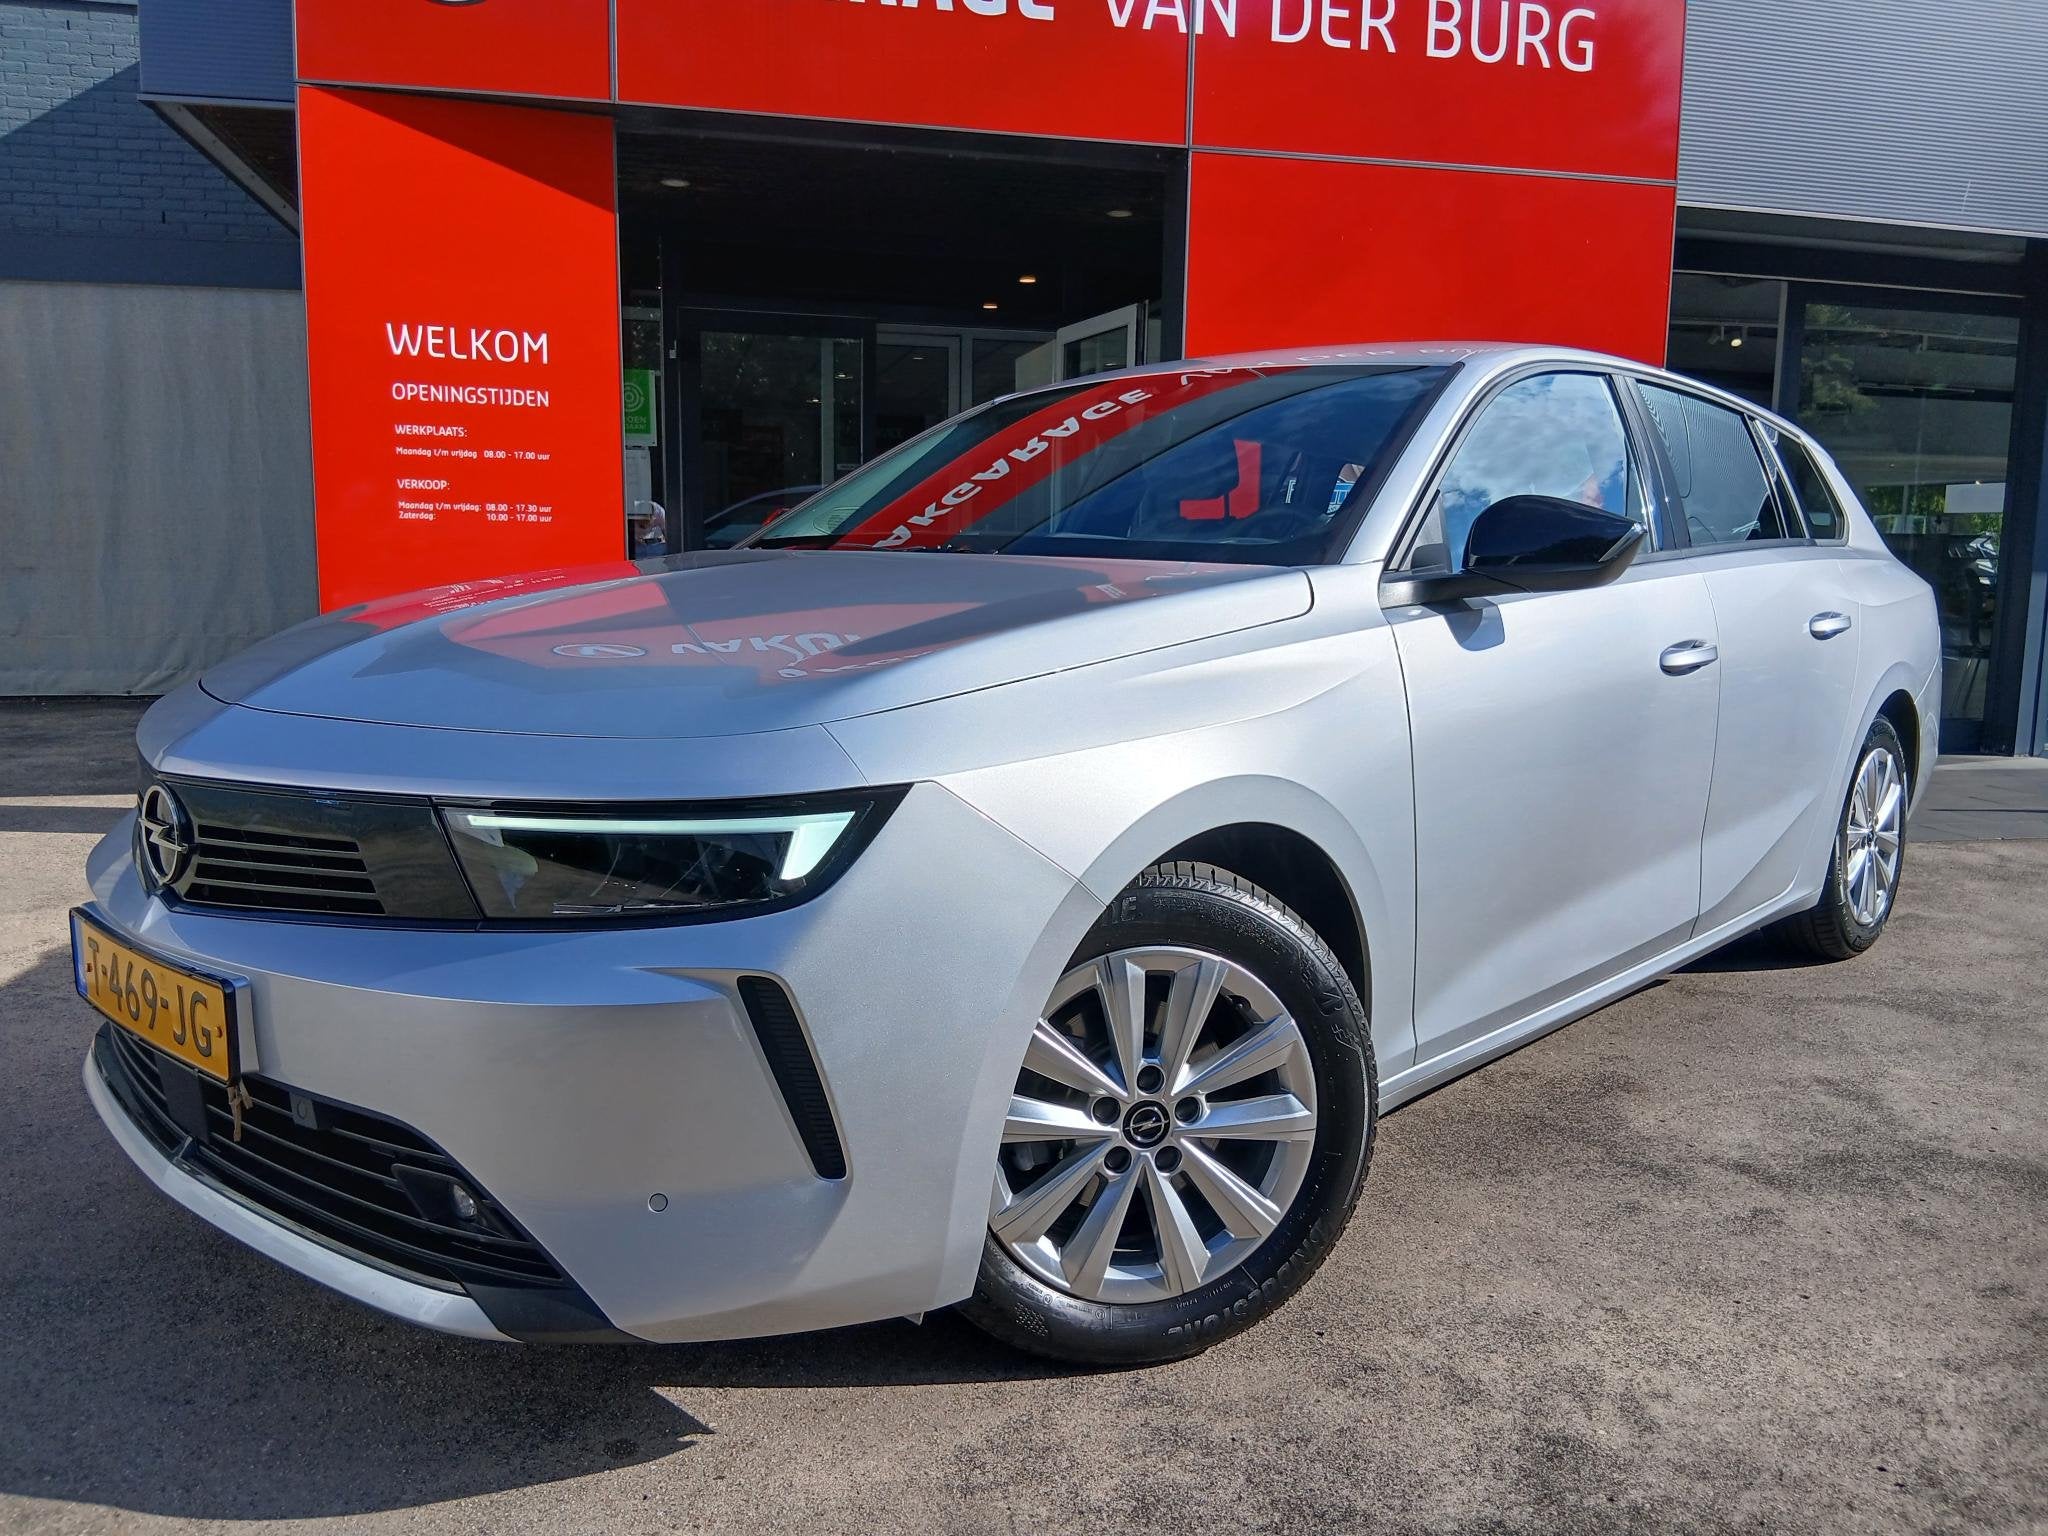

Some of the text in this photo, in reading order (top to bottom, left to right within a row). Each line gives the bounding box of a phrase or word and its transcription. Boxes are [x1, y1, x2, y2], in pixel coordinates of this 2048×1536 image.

[1272, 0, 1395, 52] DER
[1427, 0, 1595, 71] BURG
[386, 323, 547, 364] WELKOM
[392, 383, 548, 407] OPENINGSTIJDEN
[395, 425, 467, 436] WERKPLAATS:
[396, 447, 431, 457] Maandag
[451, 450, 477, 459] vrijdag
[484, 450, 506, 458] 08.00
[398, 479, 449, 489] VERKOOP:
[399, 502, 433, 511] Maandag
[453, 503, 481, 512] vrijdag:
[399, 511, 435, 520] Zaterdag:
[87, 936, 213, 1058] T-469-JG
